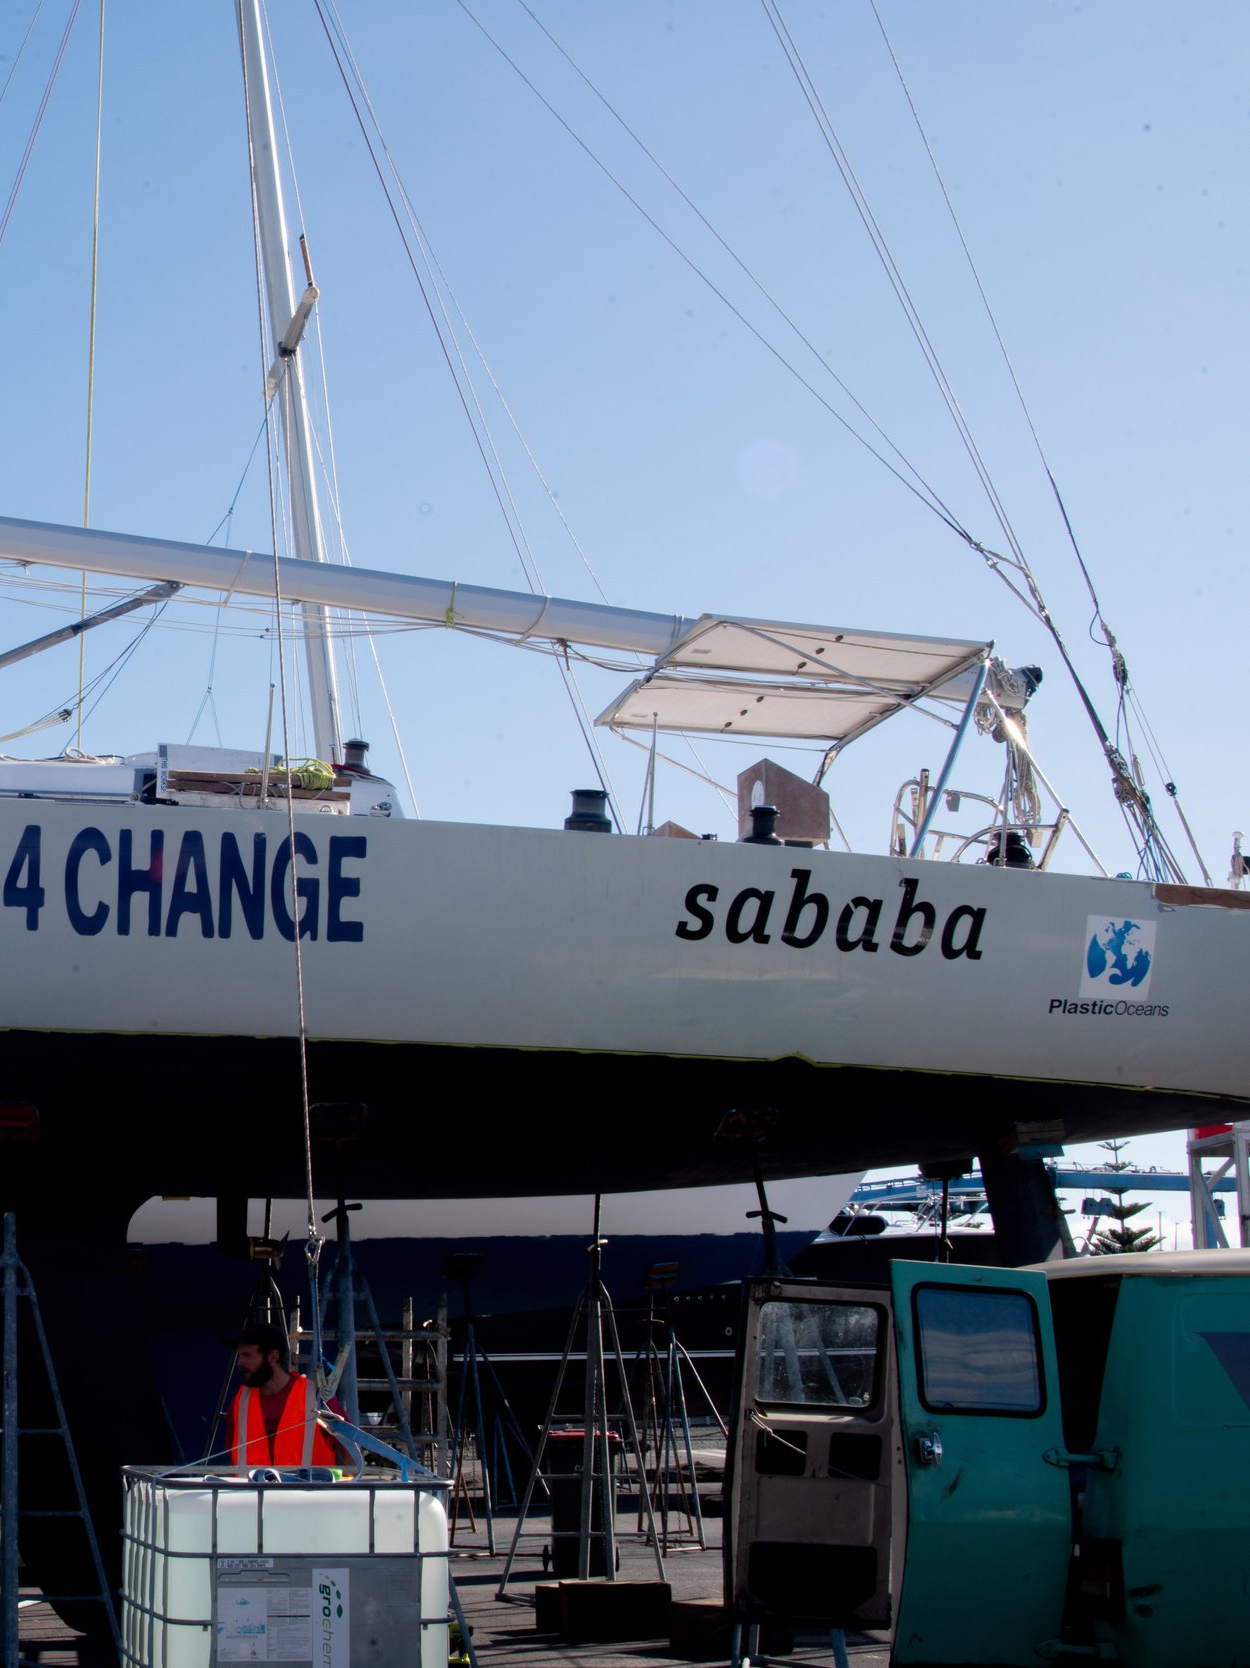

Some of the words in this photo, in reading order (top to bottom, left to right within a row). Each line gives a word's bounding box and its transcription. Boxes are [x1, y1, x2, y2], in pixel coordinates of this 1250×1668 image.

[2, 824, 45, 932] 4
[65, 826, 367, 943] CHANGE
[675, 868, 987, 961] sababa
[1049, 999, 1170, 1017] PlasticOceans
